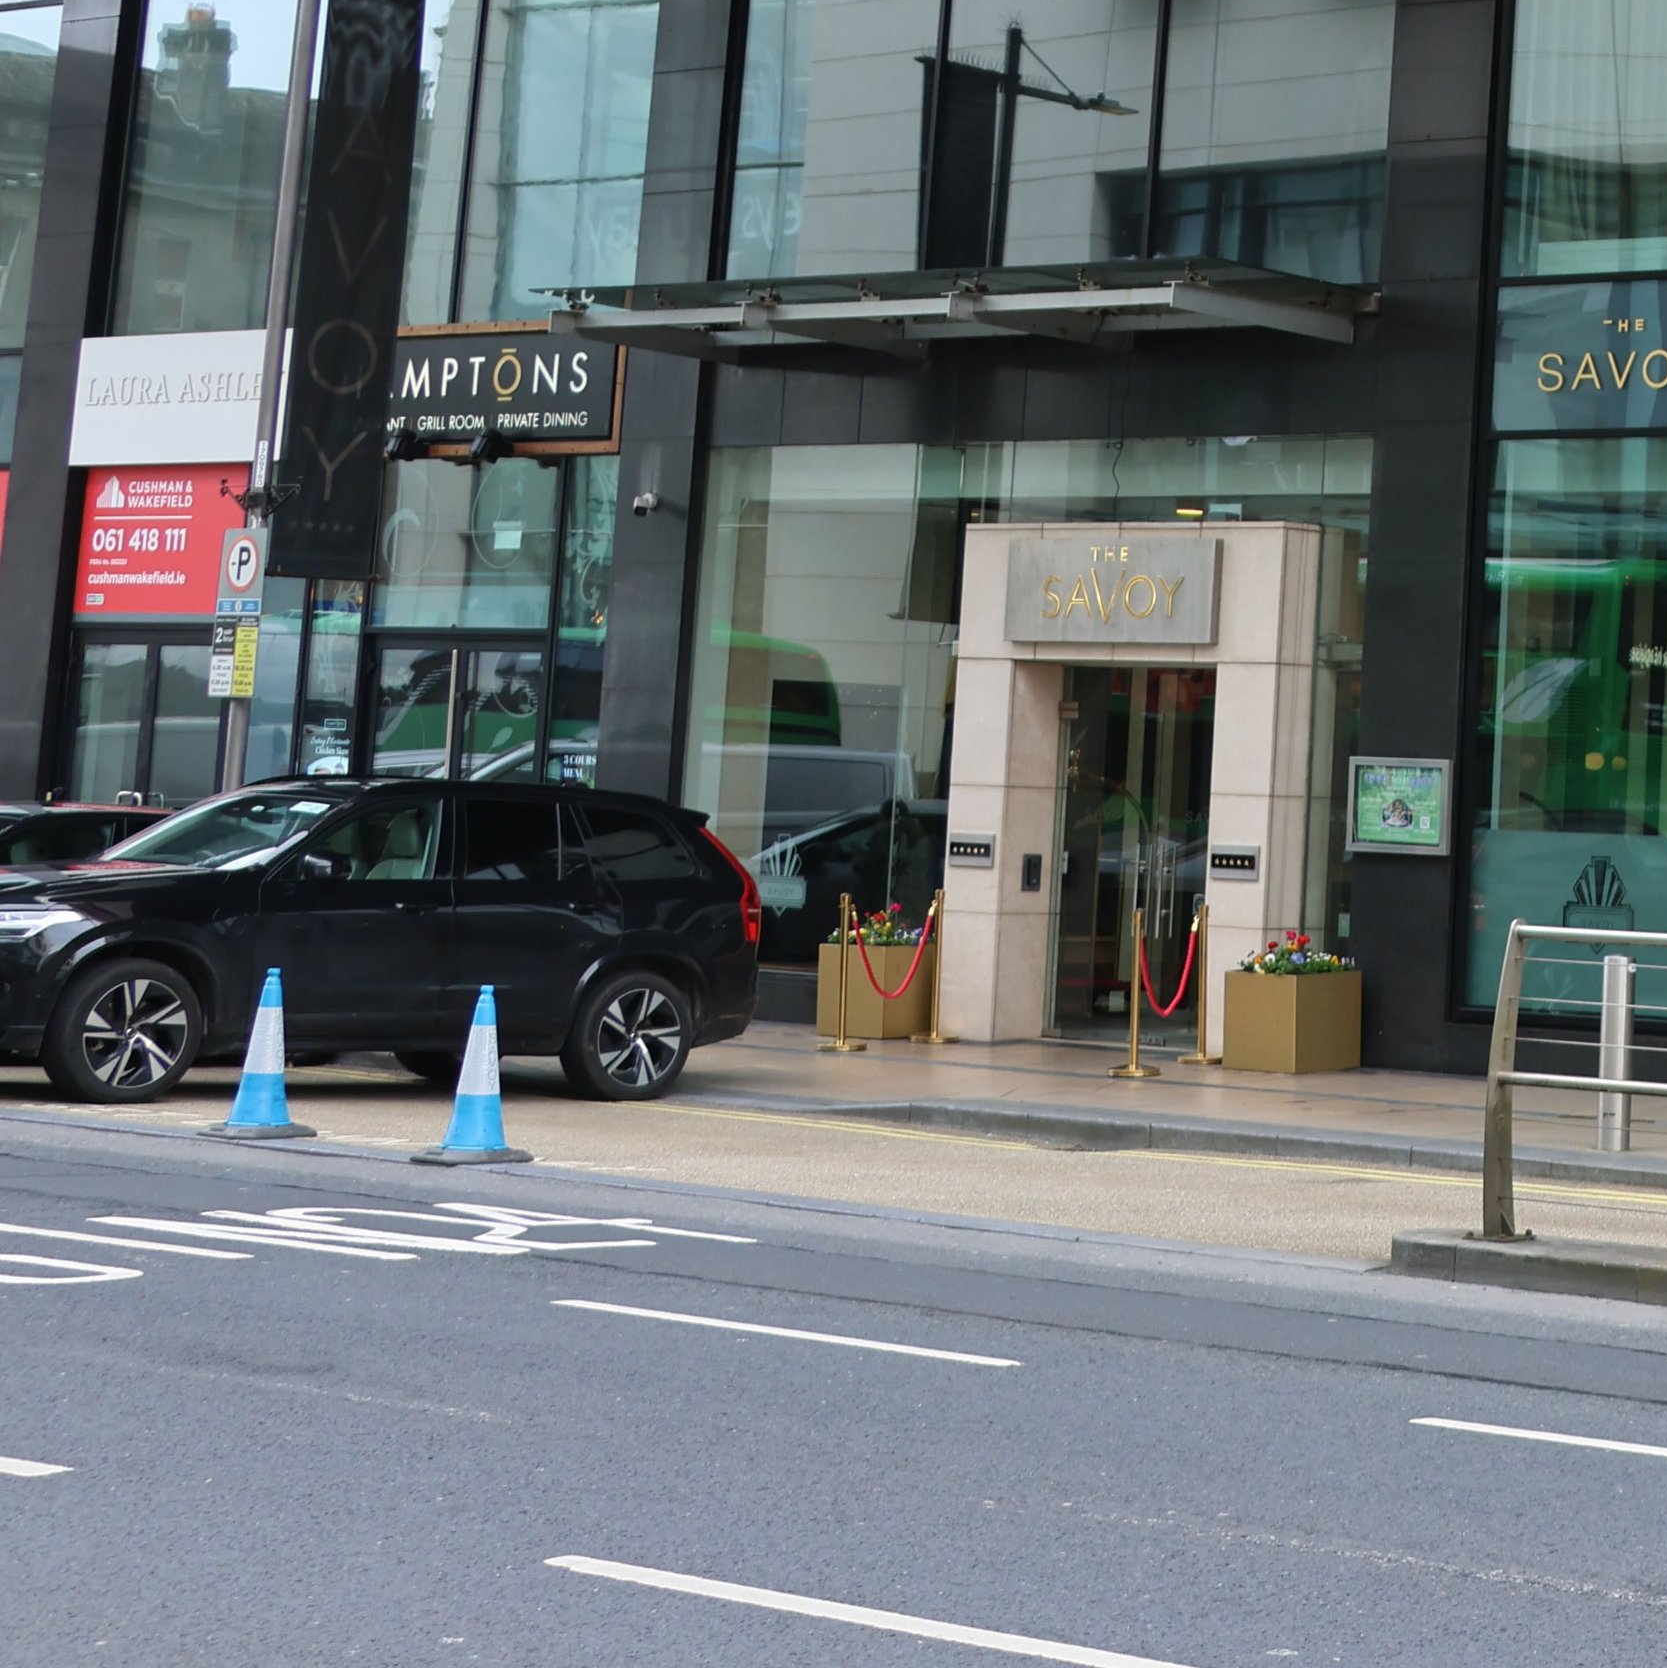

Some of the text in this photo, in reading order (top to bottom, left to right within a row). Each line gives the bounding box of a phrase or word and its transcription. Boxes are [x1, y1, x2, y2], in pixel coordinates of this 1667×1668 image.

[304, 110, 393, 501] AVOY
[84, 371, 264, 406] LAURA ASHLE
[417, 415, 446, 431] GRILL
[449, 414, 485, 430] ROOM
[497, 412, 540, 429] PRIVATE
[543, 411, 588, 428] DINING
[128, 480, 193, 494] CUSHMAN &
[127, 494, 193, 509] WAKEFIELD
[92, 528, 187, 552] 061 418 111
[1090, 546, 1130, 562] THE
[87, 570, 187, 585] cushmanwakefield.ie
[1040, 567, 1185, 625] SAVOY
